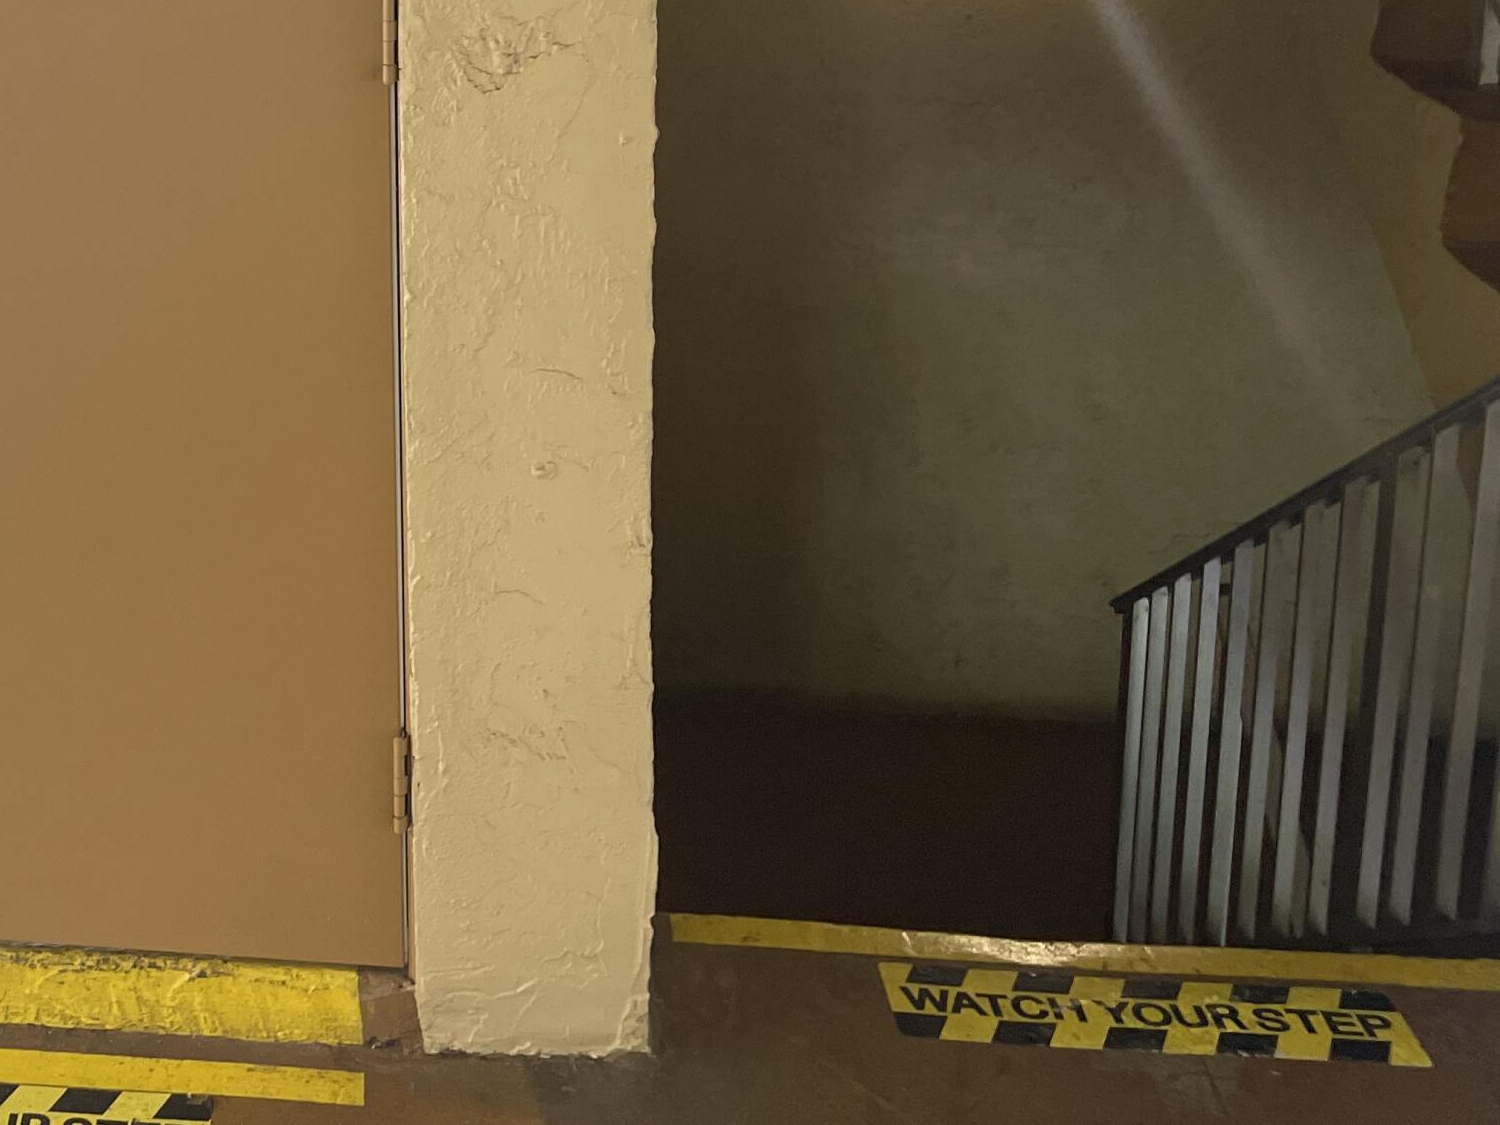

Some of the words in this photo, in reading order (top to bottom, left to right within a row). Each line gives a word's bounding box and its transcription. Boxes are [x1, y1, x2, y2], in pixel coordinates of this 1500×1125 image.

[900, 986, 1087, 1023] WATCH
[1093, 1000, 1248, 1033] YOUR
[1252, 1007, 1393, 1039] STEP
